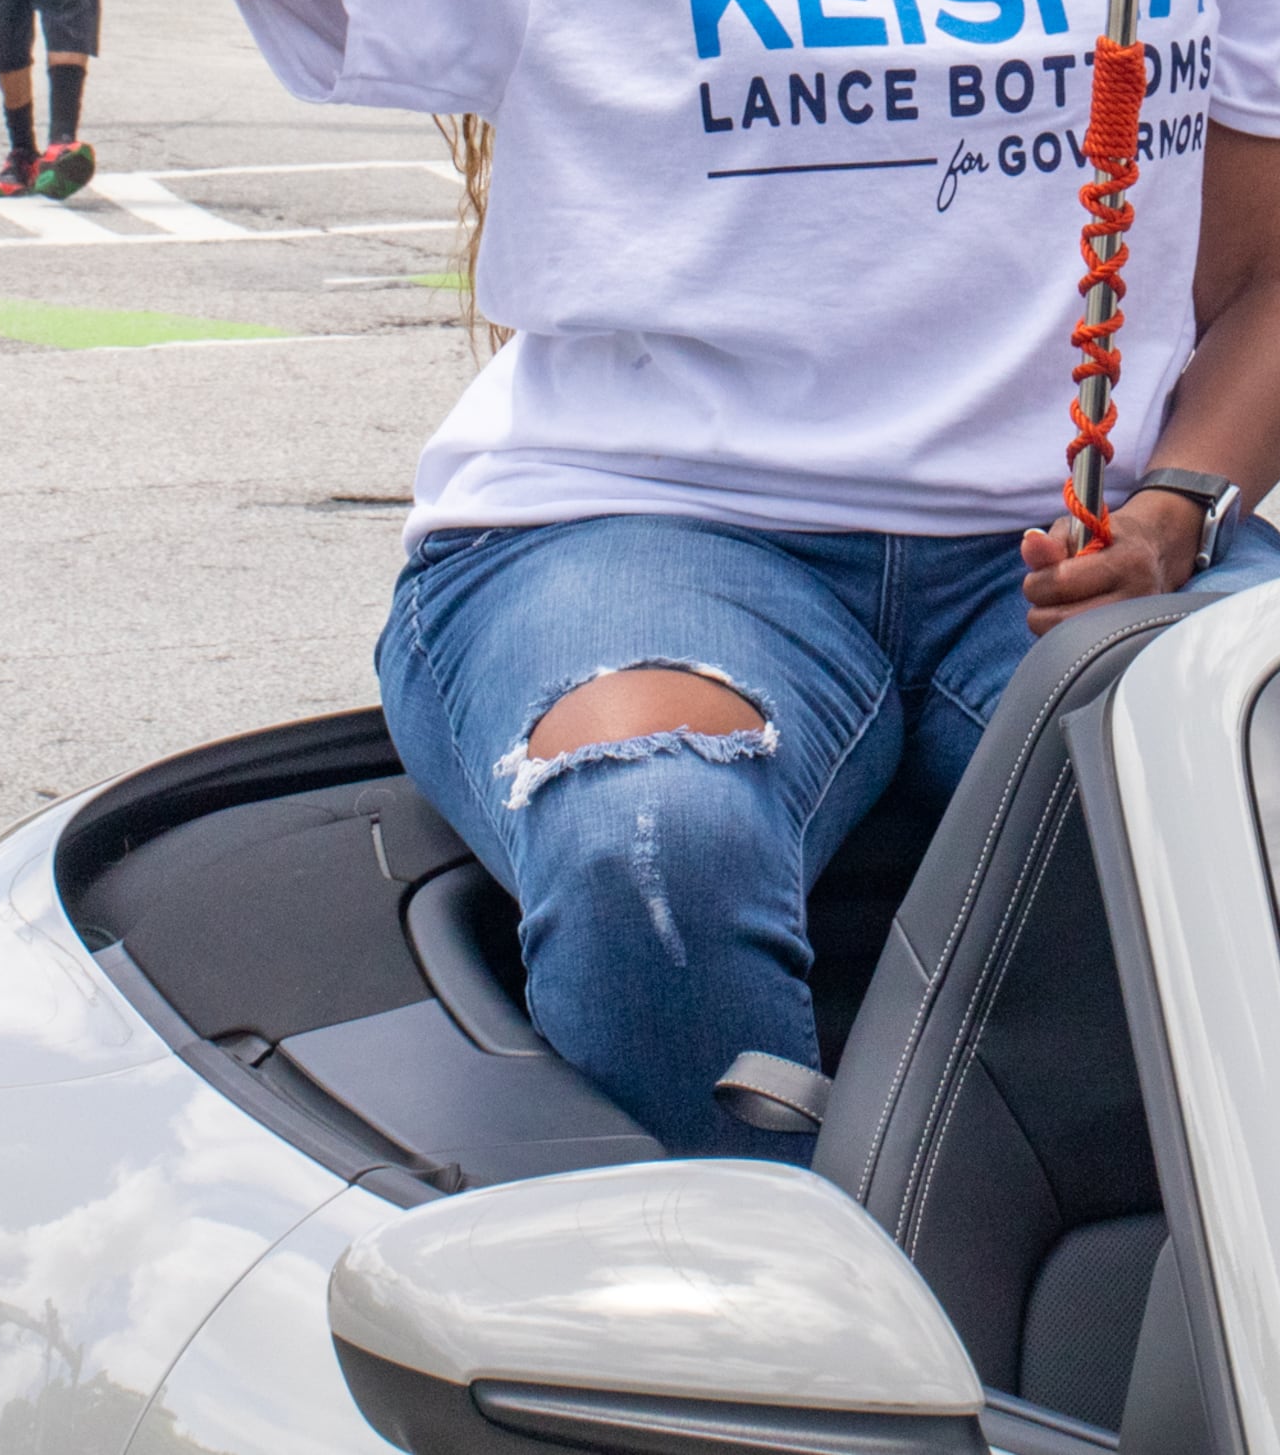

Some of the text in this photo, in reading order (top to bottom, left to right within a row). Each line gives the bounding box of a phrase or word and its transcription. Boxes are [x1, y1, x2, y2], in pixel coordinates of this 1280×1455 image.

[700, 34, 1212, 132] LANCE BOTOMS
[937, 112, 1204, 213] for GOVRNOR
